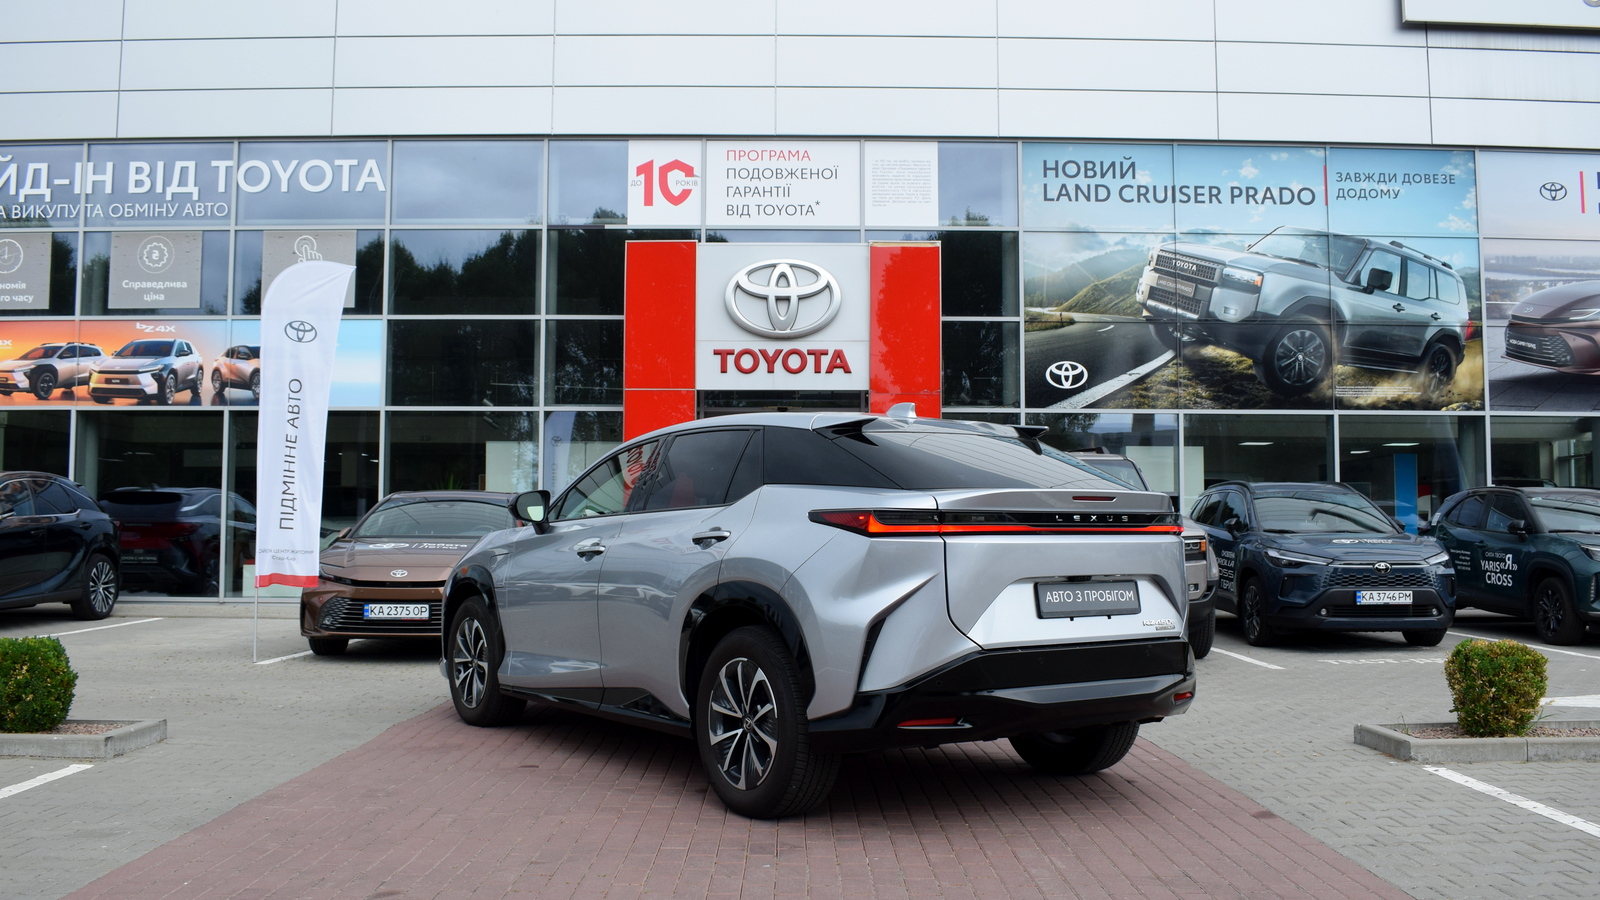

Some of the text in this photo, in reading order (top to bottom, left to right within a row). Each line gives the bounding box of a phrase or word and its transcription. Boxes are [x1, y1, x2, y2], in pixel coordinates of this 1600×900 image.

[726, 149, 811, 162] ПРОГРАМА
[726, 165, 840, 182] ПОДОВЖЕНОЇ
[1042, 156, 1137, 180] НОВИЙ
[128, 160, 199, 201] ВІД
[211, 158, 386, 193] TOYOTA
[630, 179, 642, 188] ДО
[675, 179, 699, 187] РОКІВ
[1335, 171, 1456, 186] ЗАВЖДИ ДОВЕЗЕ
[726, 184, 791, 198] ГАРАНТІЇ
[1043, 183, 1316, 206] LAND CRUISER PRADO
[1336, 188, 1401, 201] ДОДОМУ
[12, 204, 80, 219] ВИКУПУ
[85, 204, 104, 218] ТА
[109, 202, 179, 218] ОБМІНУ
[183, 202, 229, 217] АВТО
[726, 204, 751, 219] ВІД
[1172, 260, 1197, 271] TOYOTA
[122, 279, 187, 290] Справедлива
[12, 295, 34, 303] часу
[143, 292, 165, 302] ціна
[713, 348, 852, 375] TOYOTA
[279, 378, 303, 530] ПІДМІННЕ АВТО
[1056, 514, 1128, 522] LEXUS
[1480, 560, 1500, 572] YARIS
[1485, 572, 1513, 587] CROSS
[1046, 590, 1073, 604] АВТО
[1084, 590, 1134, 602] ПРОБІГОМ
[1361, 592, 1412, 602] KA 3746 PM
[370, 605, 428, 616] KA 2375 OP
